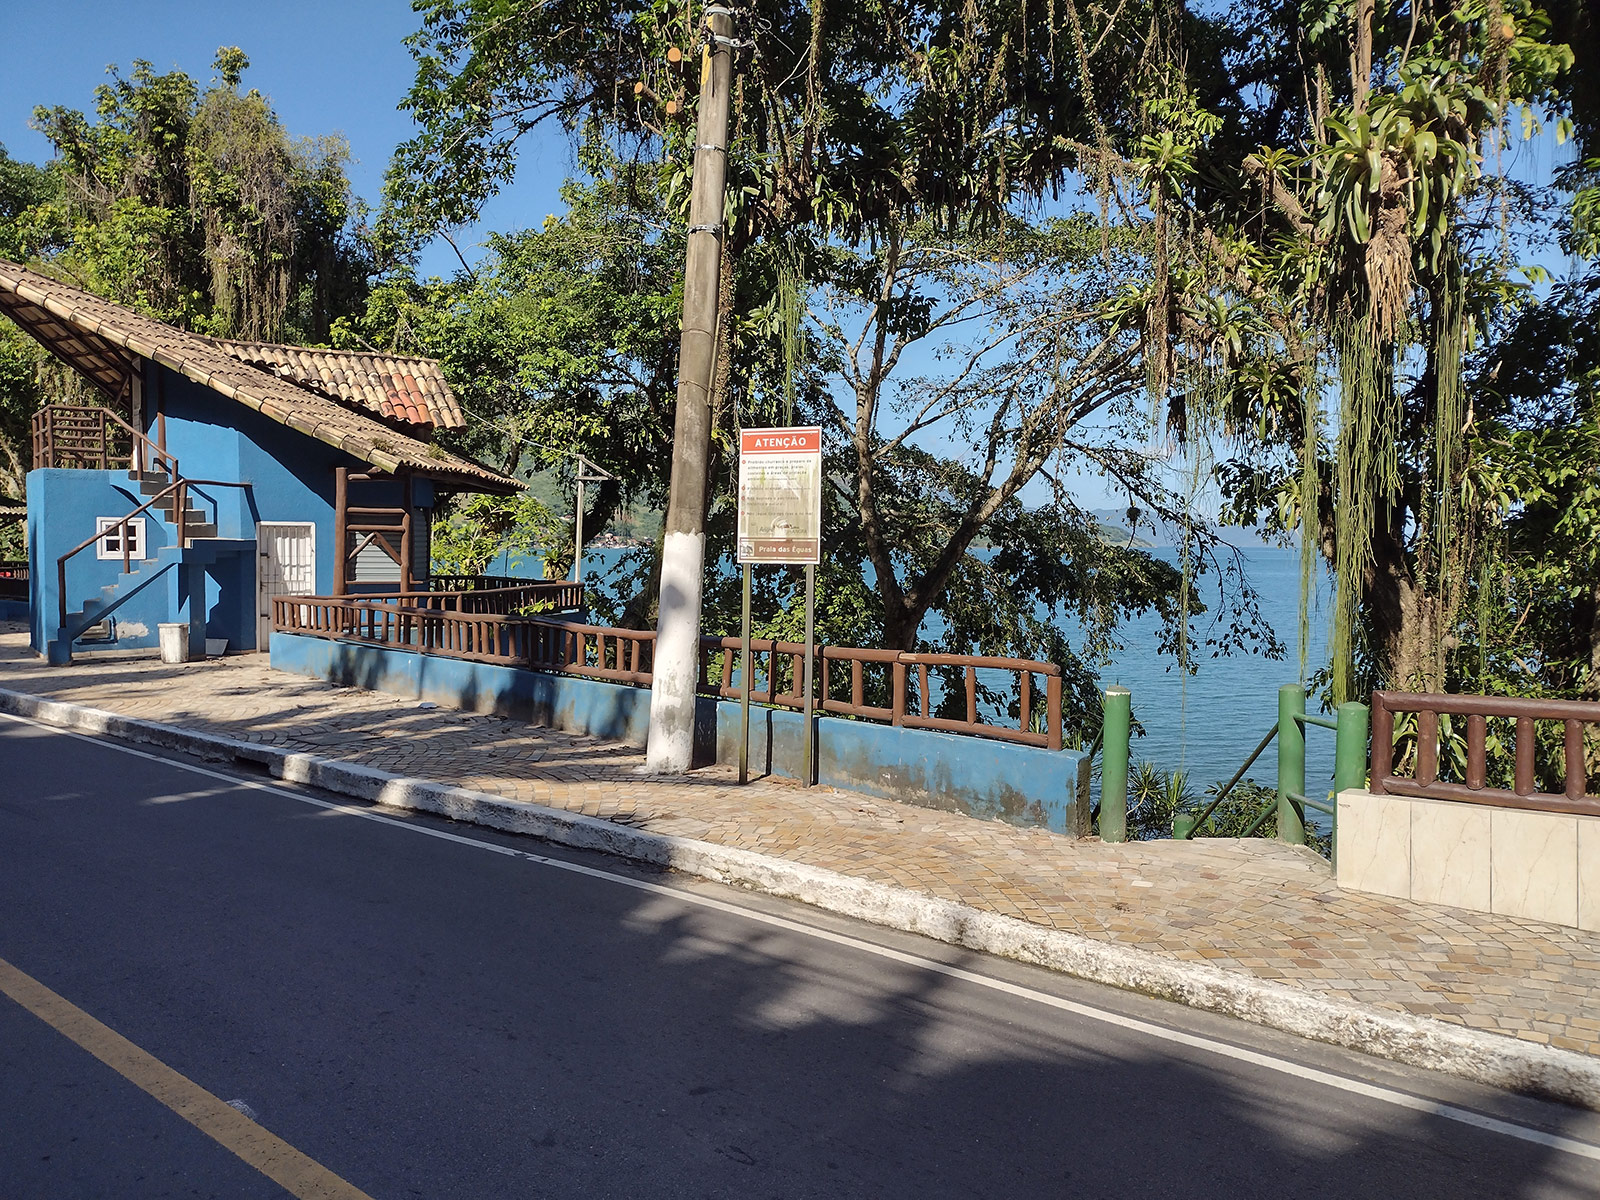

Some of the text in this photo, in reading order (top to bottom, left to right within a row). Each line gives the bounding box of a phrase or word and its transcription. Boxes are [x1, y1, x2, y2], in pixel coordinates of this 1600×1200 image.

[755, 436, 807, 448] ATENÇÃO
[759, 545, 812, 554] Praia das Éguas
